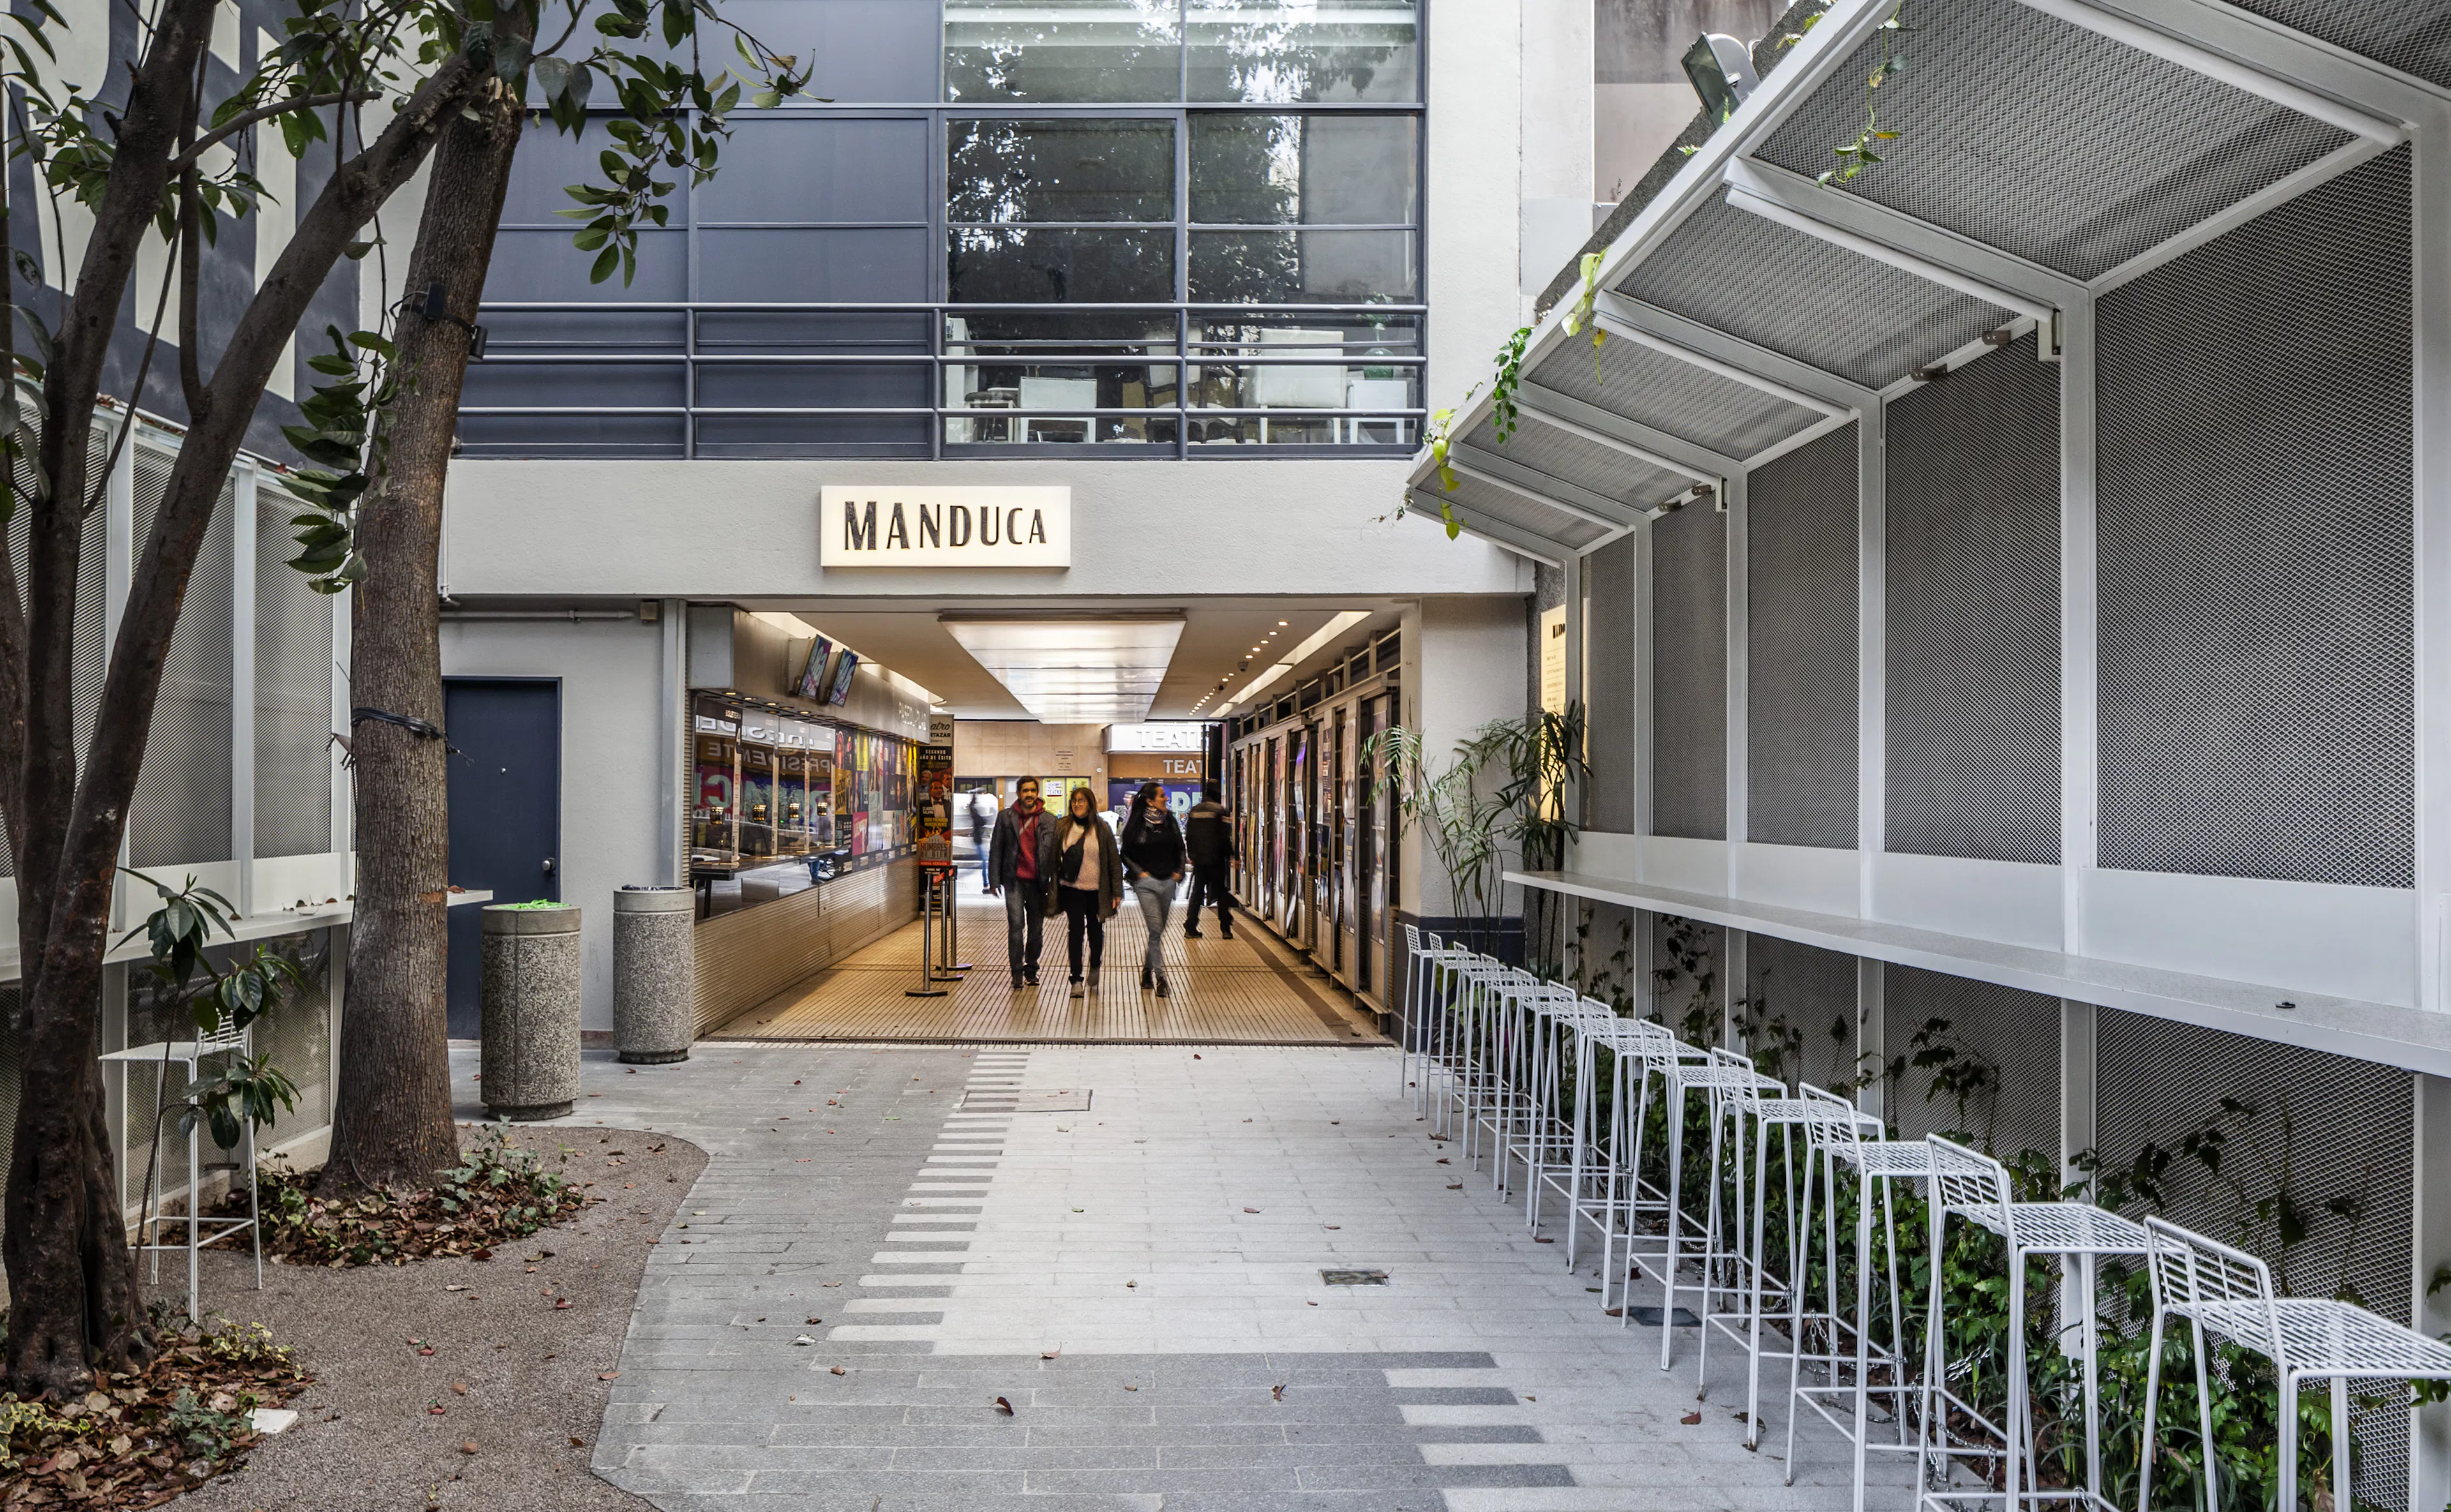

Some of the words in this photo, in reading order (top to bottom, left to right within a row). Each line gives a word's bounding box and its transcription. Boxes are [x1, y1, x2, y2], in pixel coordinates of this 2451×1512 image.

[844, 501, 1047, 550] MANDUCA
[930, 721, 950, 730] atro
[1163, 760, 1203, 774] TEAT
